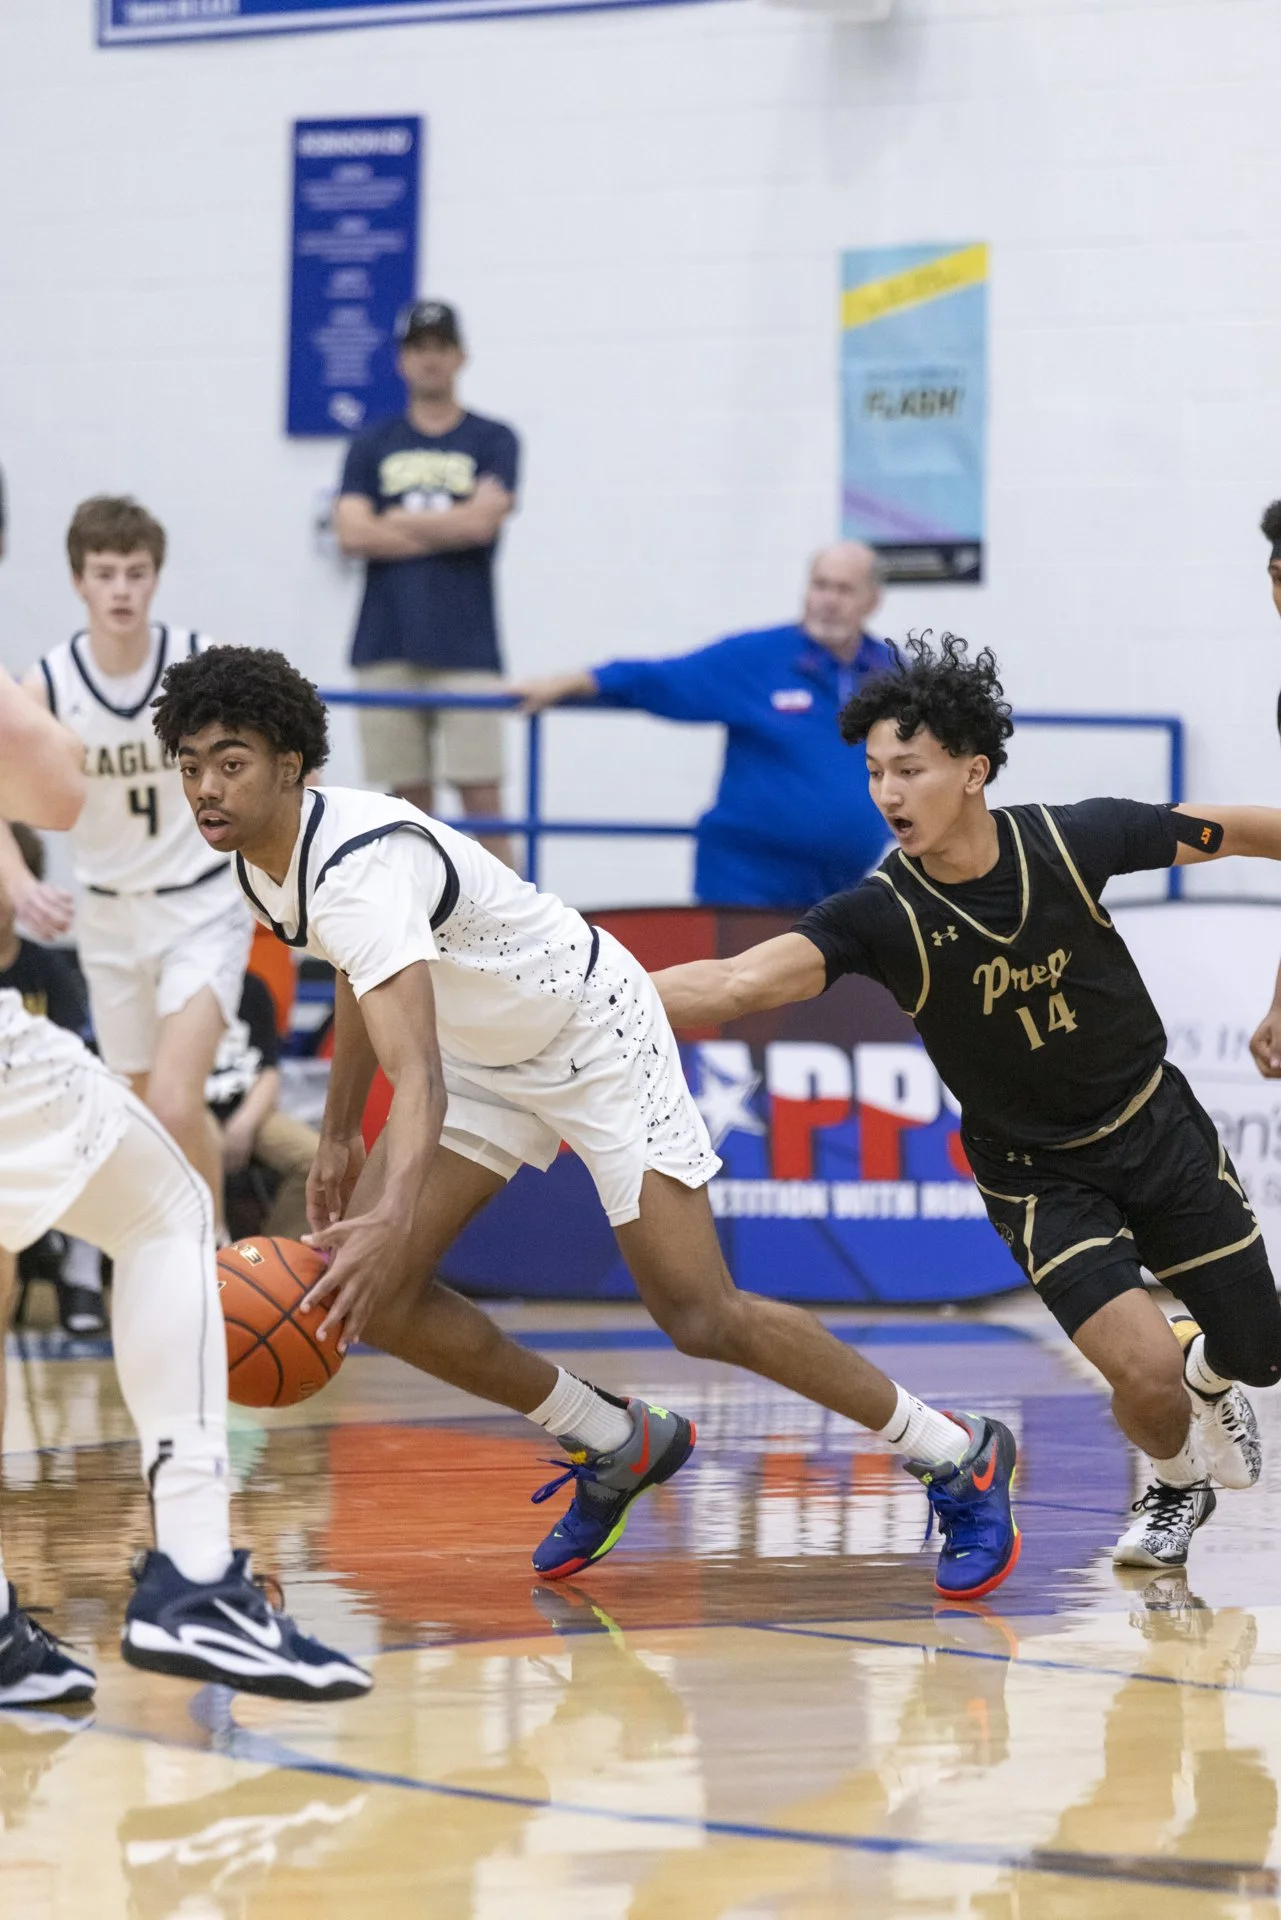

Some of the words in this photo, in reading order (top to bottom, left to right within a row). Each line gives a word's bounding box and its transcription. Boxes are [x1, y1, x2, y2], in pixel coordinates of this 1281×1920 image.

[127, 785, 158, 837] 4
[973, 948, 1072, 1016] Prep
[1015, 992, 1079, 1051] 14
[832, 1181, 918, 1219] WITH
